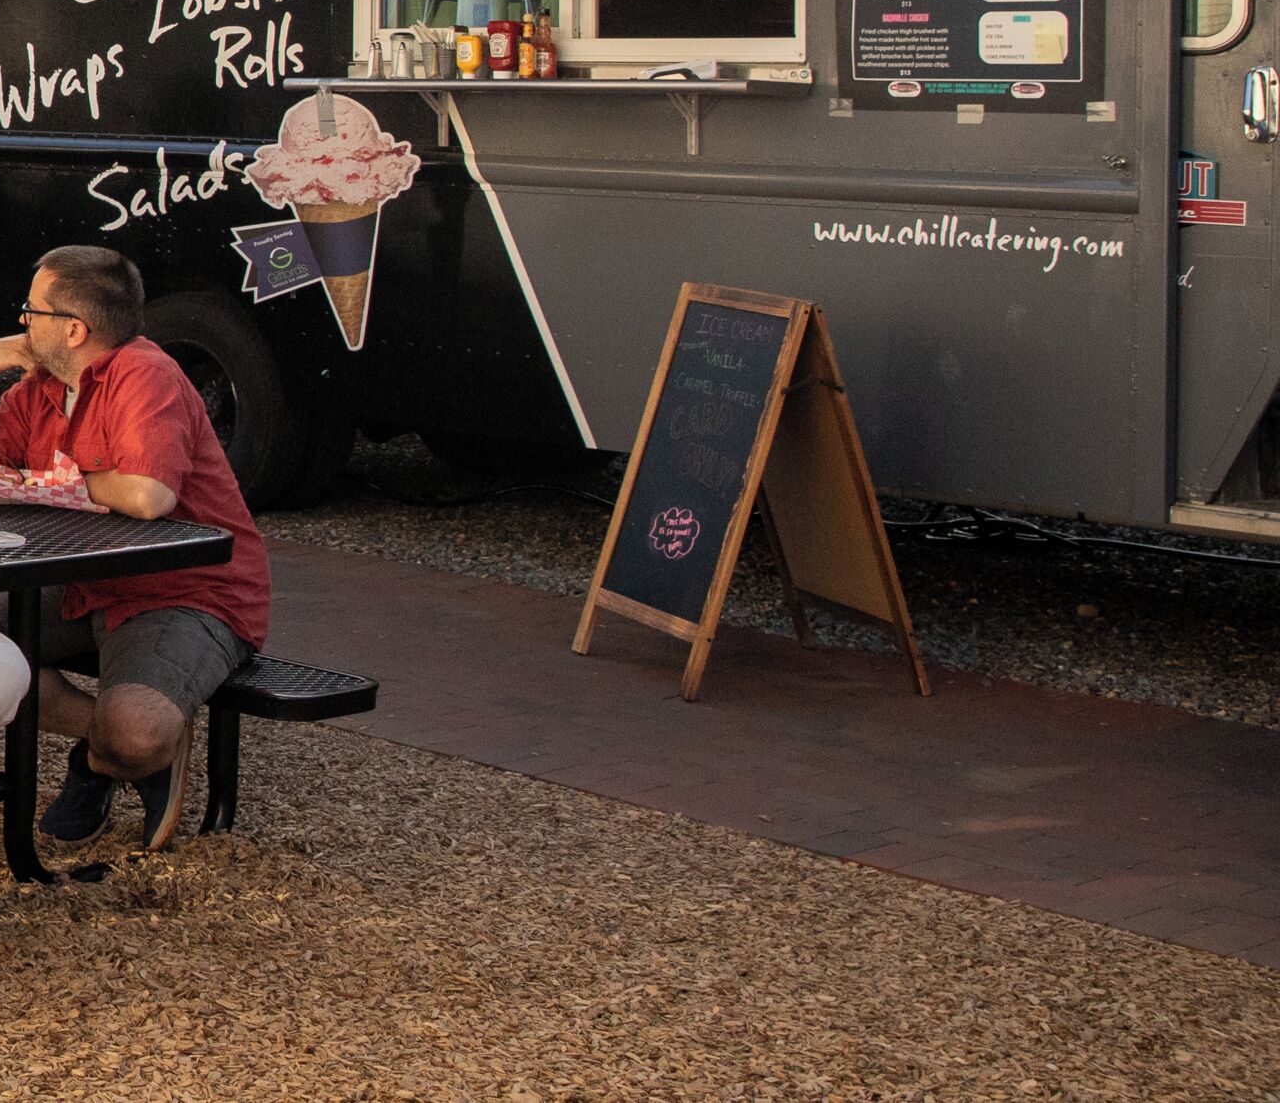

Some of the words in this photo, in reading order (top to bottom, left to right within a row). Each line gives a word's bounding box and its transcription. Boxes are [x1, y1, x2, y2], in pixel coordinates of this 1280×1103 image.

[210, 11, 304, 88] Rolls
[87, 139, 252, 231] Salads
[273, 230, 293, 239] Serving
[814, 215, 1123, 273] www.chillcatering.com
[696, 314, 728, 336] ICE
